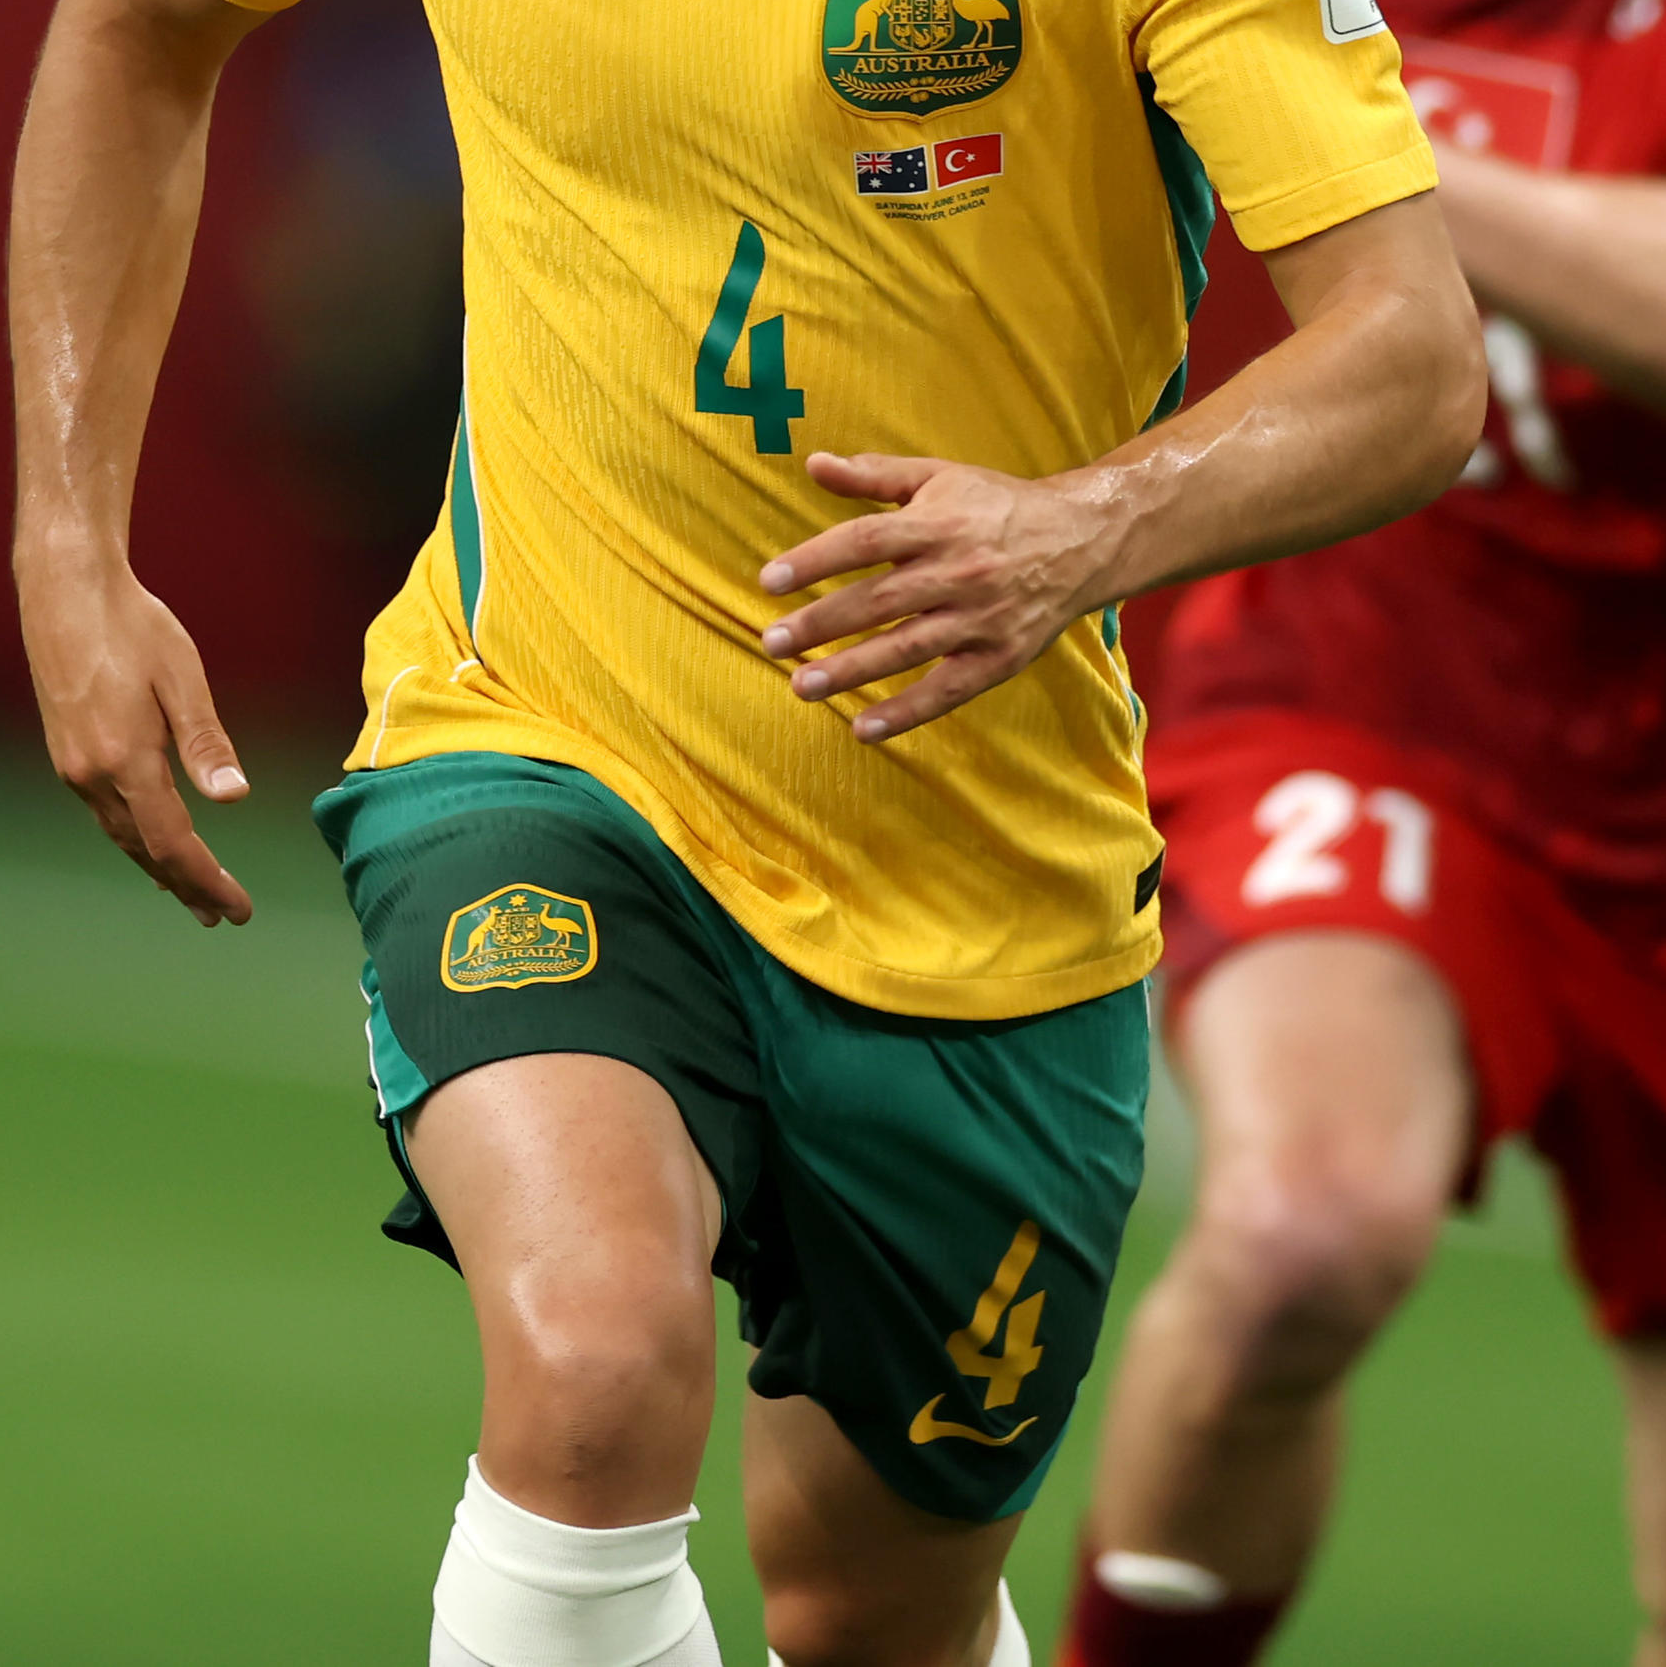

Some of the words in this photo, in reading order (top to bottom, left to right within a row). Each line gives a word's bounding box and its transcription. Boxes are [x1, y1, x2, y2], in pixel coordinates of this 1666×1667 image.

[853, 53, 991, 75] AUSTRALIA
[875, 202, 929, 210] SATURDAY
[932, 196, 955, 209] JUNE
[970, 186, 990, 198] 2026
[948, 199, 986, 216] CANADA
[695, 220, 805, 454] 4
[1240, 769, 1435, 920] 21
[467, 947, 568, 970] AUSTRALIA
[945, 1219, 1046, 1410] 4
